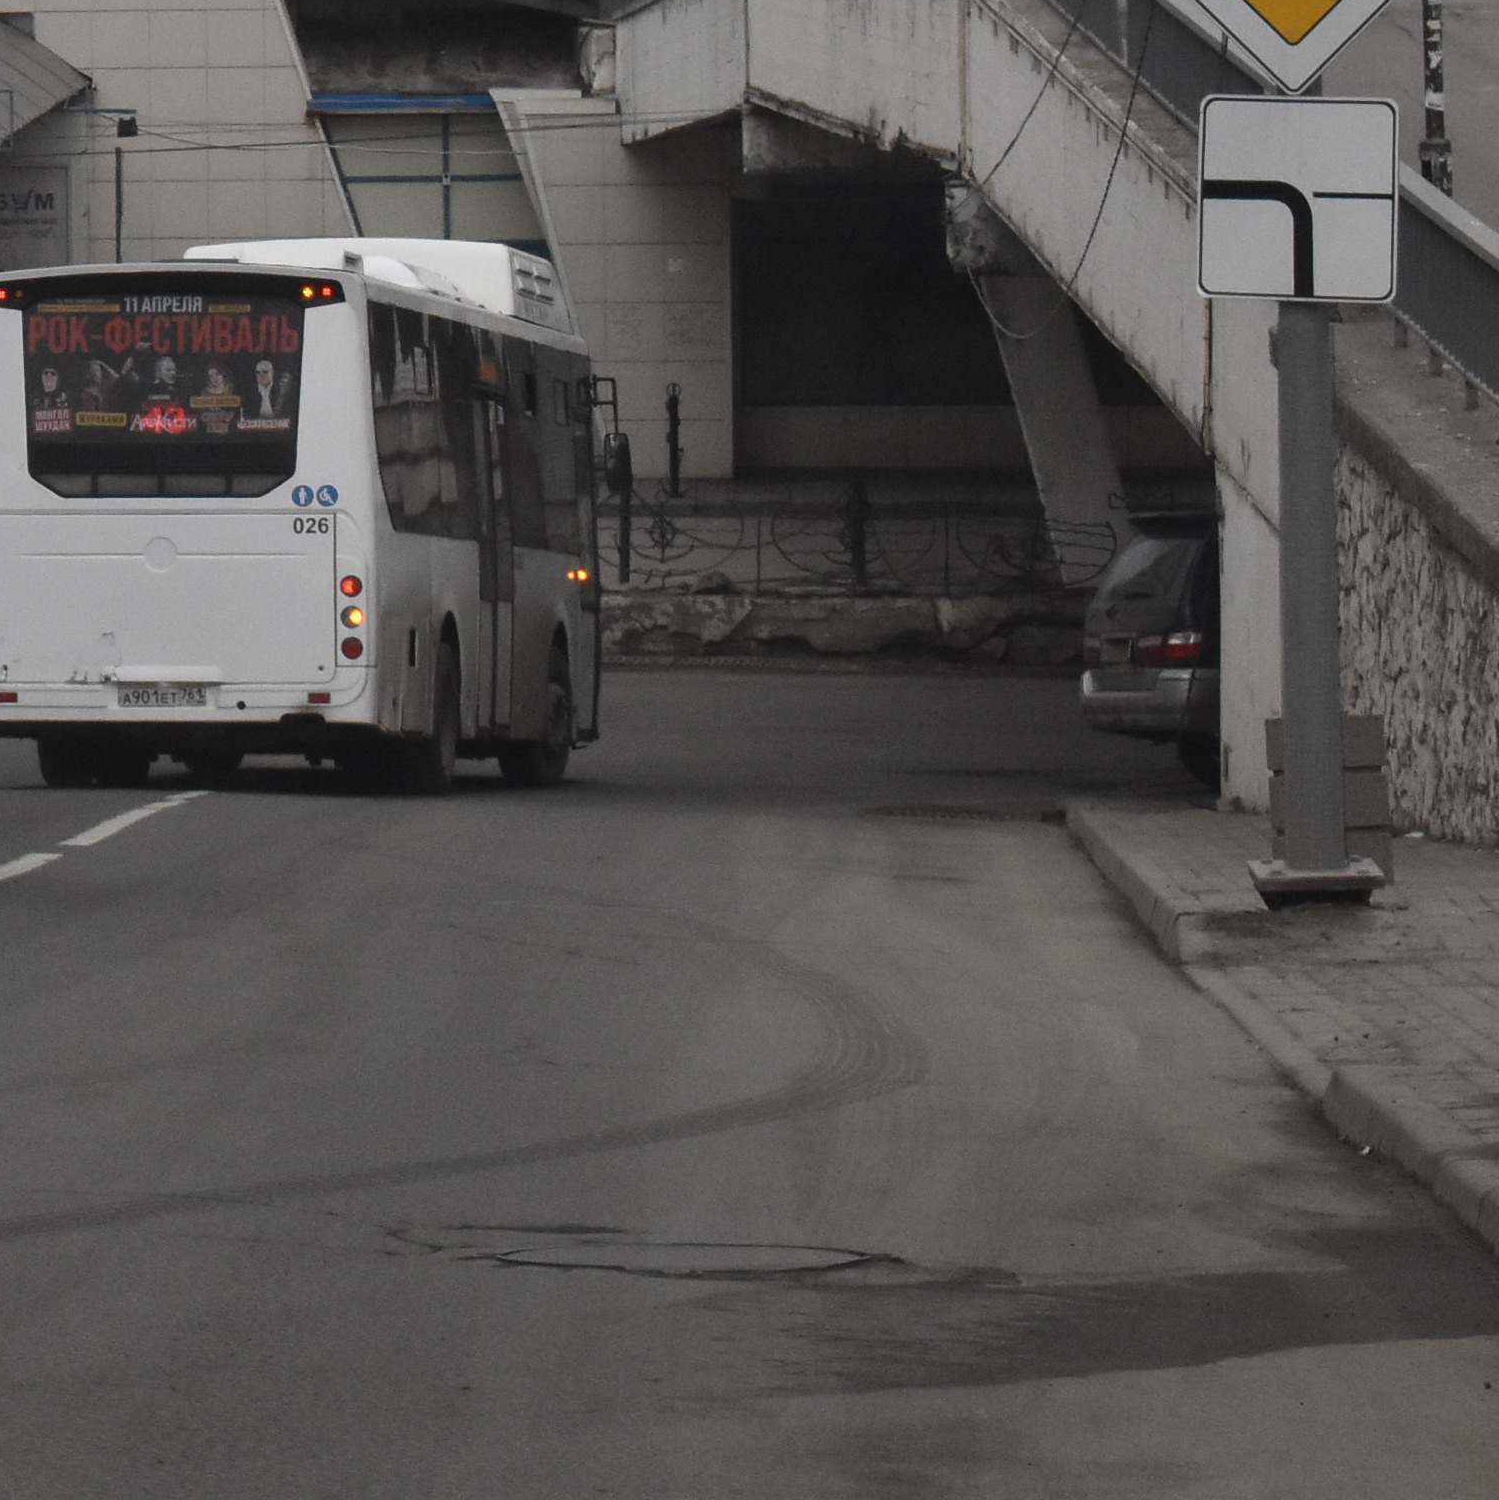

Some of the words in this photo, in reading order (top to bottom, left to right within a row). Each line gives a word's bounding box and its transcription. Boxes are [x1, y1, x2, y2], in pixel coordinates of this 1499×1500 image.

[124, 297, 141, 313] 11
[142, 296, 203, 313] АПРЕЛЯ
[28, 314, 300, 355] РОК-ФЕСТИВАЛЬ
[293, 517, 329, 534] 026
[122, 690, 180, 705] А901ЕТ
